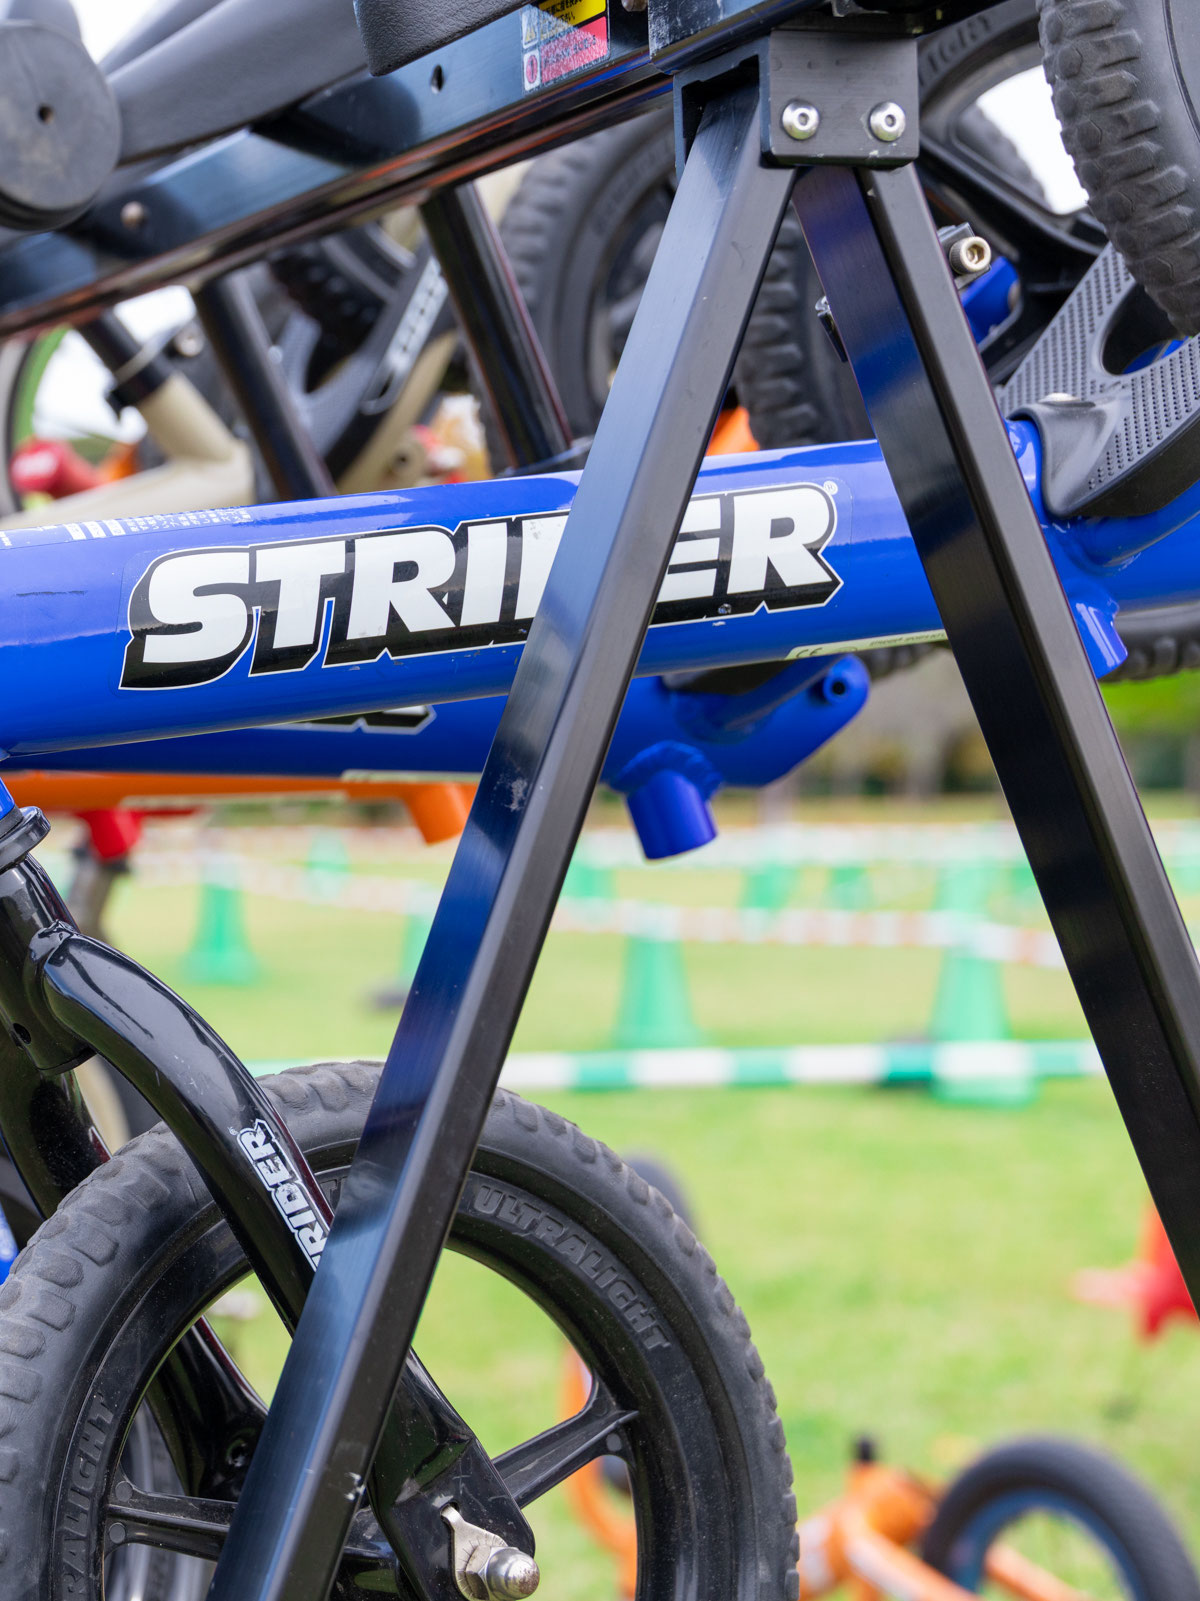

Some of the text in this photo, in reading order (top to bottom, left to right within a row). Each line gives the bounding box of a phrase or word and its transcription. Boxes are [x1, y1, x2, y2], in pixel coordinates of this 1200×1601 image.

[238, 1118, 330, 1272] RIDER
[473, 1184, 672, 1350] ULTRALIGHT
[60, 1393, 115, 1601] RALIGHT
